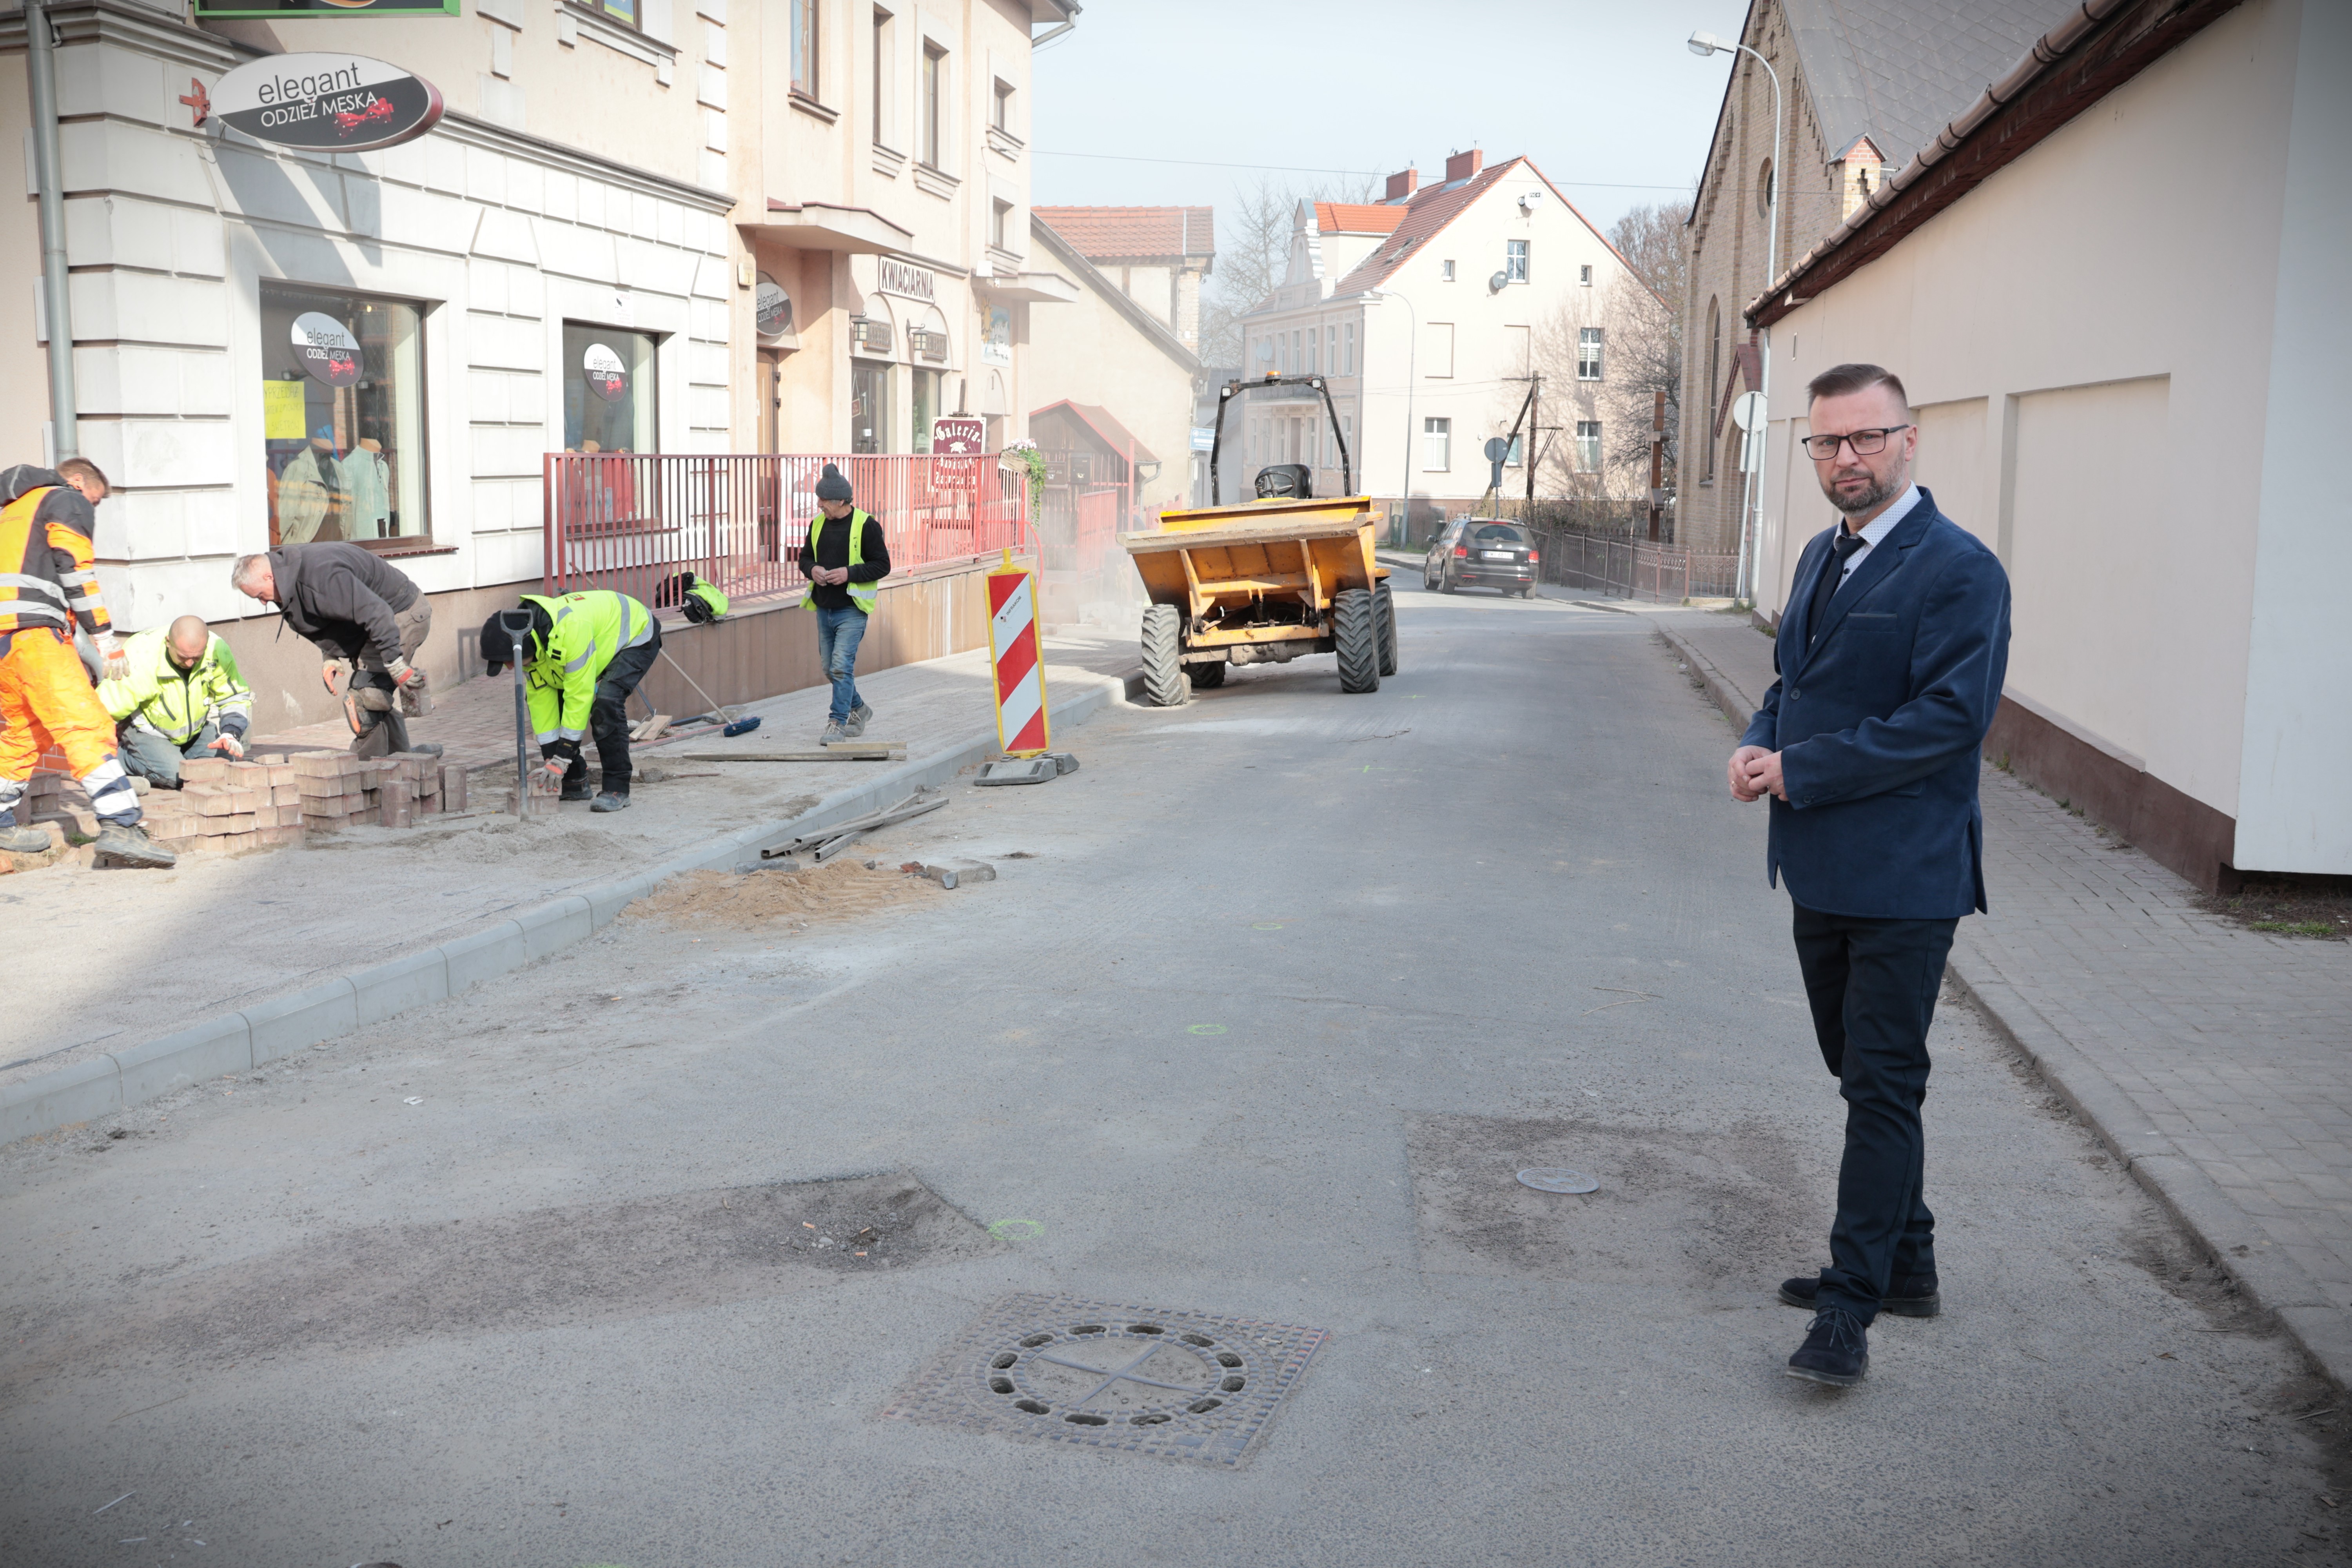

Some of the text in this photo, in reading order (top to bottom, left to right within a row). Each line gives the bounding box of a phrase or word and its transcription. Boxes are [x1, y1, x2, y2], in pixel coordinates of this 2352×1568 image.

[258, 62, 361, 104] elegant
[261, 91, 379, 127] ODZIEŻ MĘSKA
[882, 260, 934, 300] KWIACIARNIA
[757, 289, 779, 310] elegant
[307, 327, 345, 350] elegant
[307, 347, 350, 362] ODZIEŻ MĘSKA
[593, 356, 616, 372] elegant
[936, 422, 980, 442] Galeria
[1006, 595, 1022, 615] INFRAKOM
